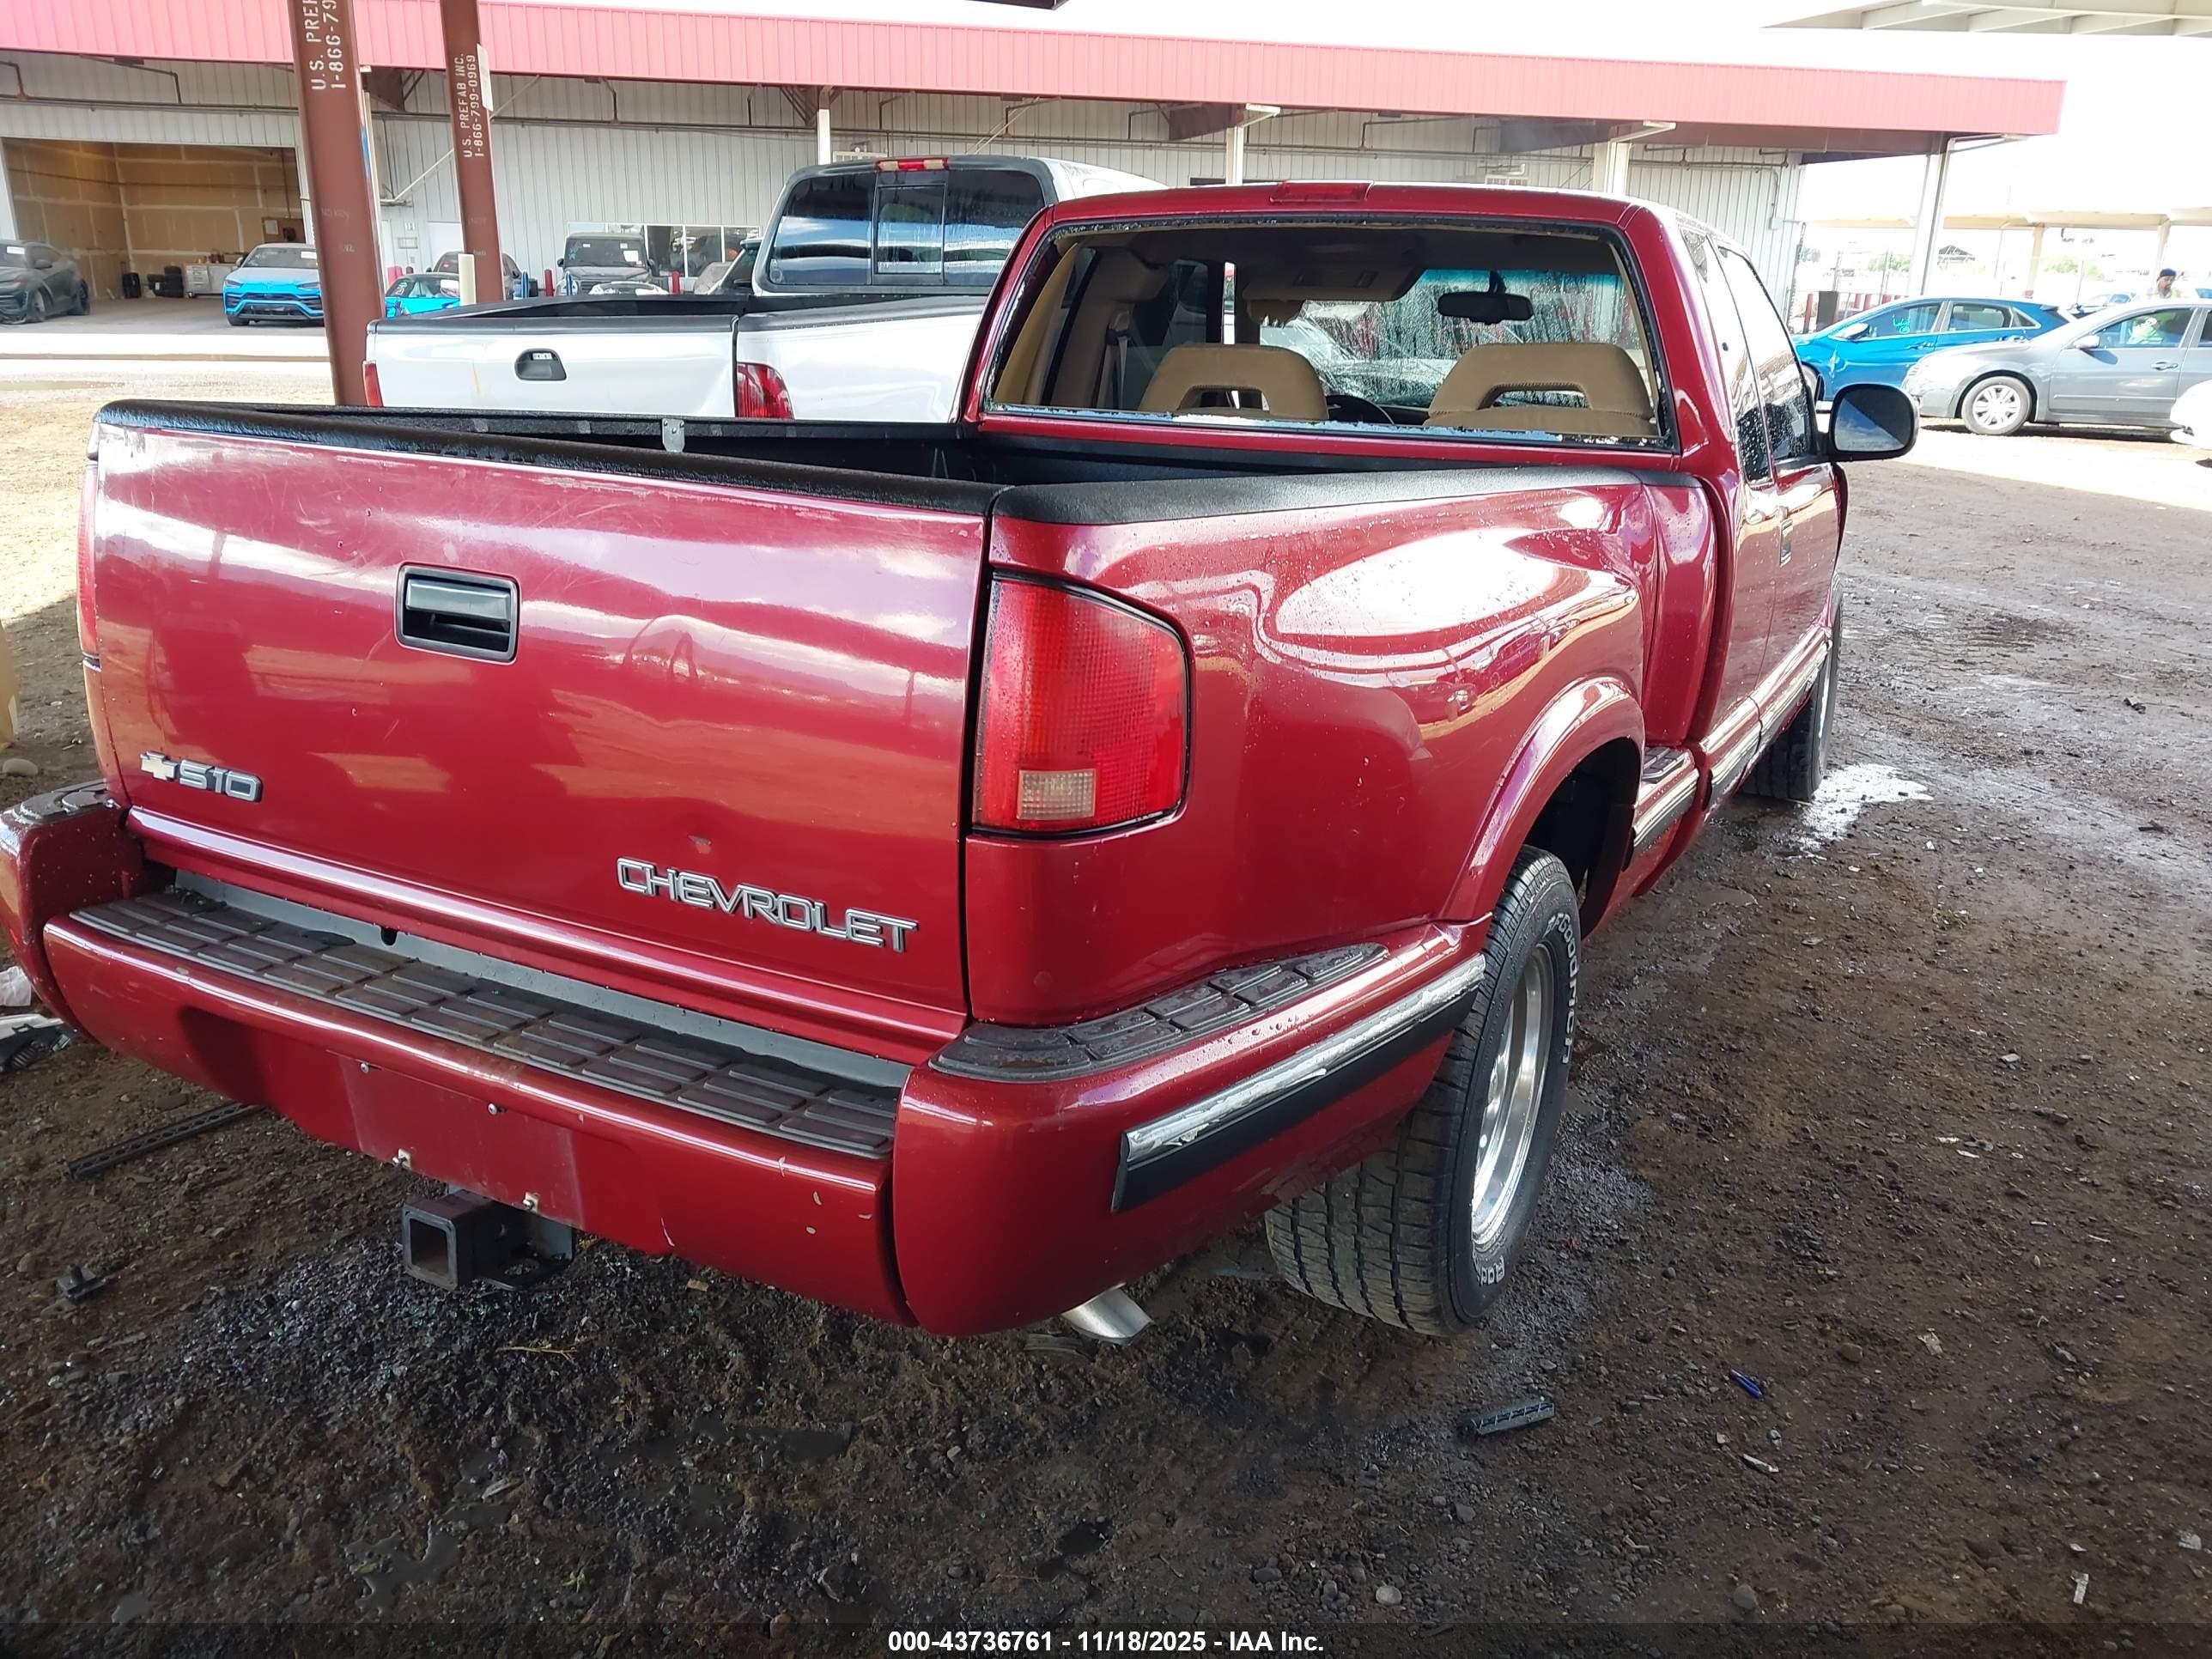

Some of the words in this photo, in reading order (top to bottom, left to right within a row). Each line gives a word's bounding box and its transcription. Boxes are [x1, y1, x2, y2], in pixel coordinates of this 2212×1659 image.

[309, 55, 326, 89] U.S.
[454, 53, 465, 76] INC.
[456, 82, 470, 129] PREFAB
[466, 55, 484, 157] 1-866-799-0969
[462, 135, 473, 158] U.S.
[179, 759, 262, 802] S10
[617, 858, 920, 952] CHEVROLET
